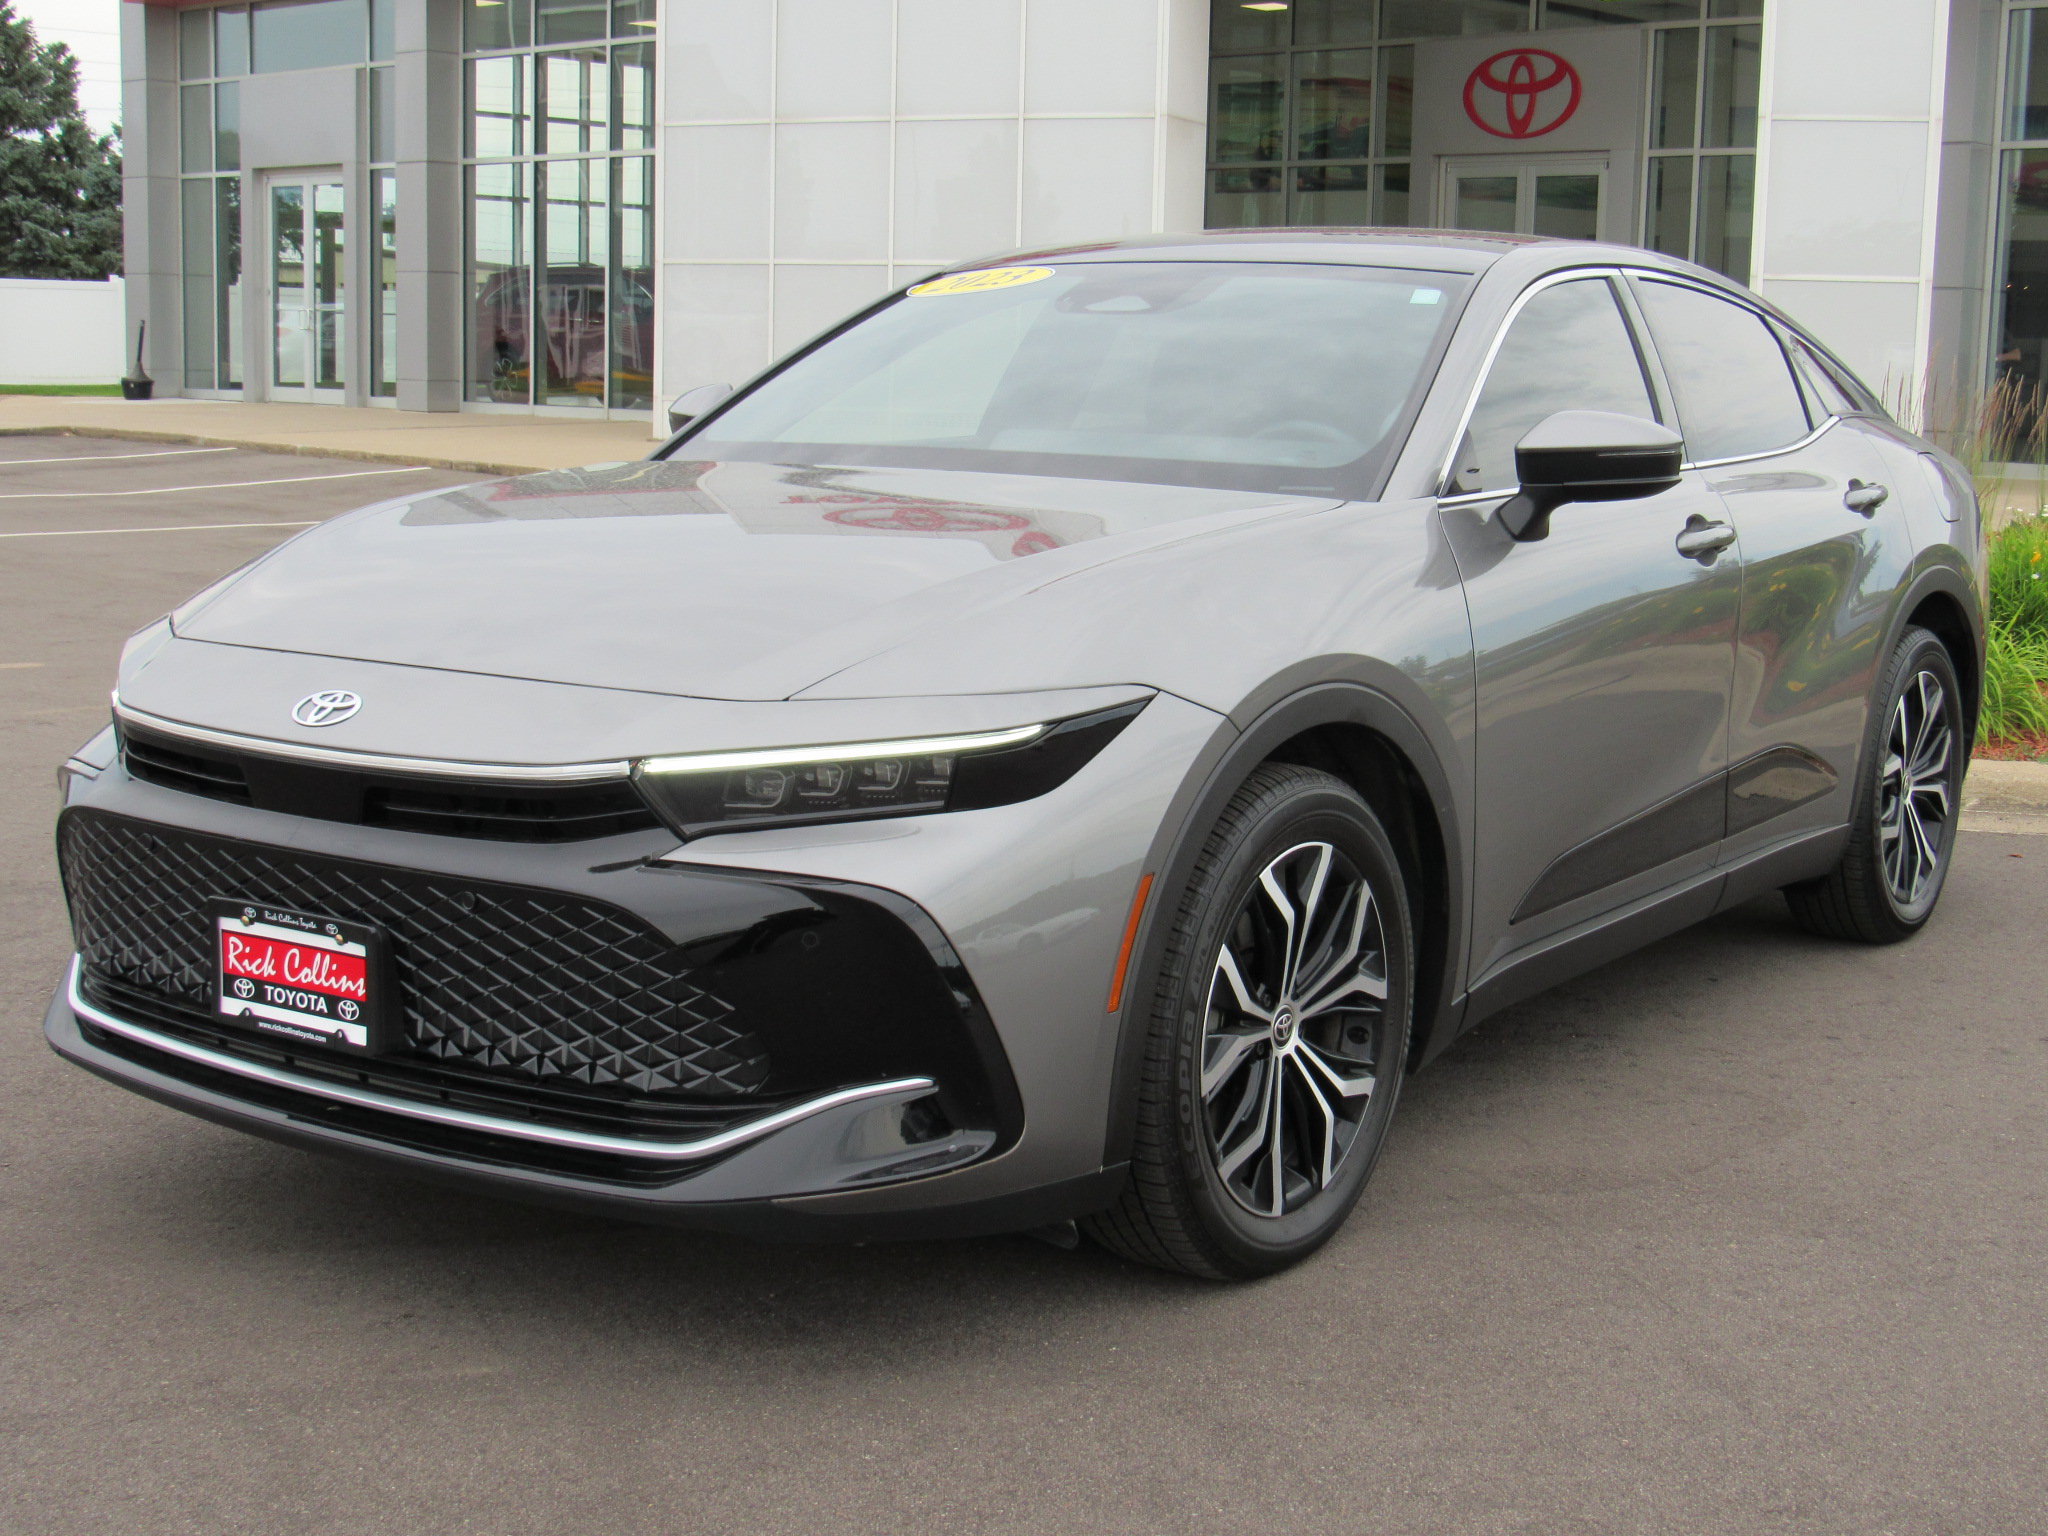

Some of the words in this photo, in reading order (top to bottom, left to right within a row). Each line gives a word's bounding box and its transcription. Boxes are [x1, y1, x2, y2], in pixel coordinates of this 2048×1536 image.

[264, 910, 278, 922] Rick
[278, 913, 300, 926] Collins
[300, 917, 317, 930] Toyota
[228, 936, 277, 978] Rick
[283, 948, 366, 997] Collins
[264, 984, 329, 1014] TOYOTA
[258, 1021, 327, 1044] www.rickcollinstoyota.com
